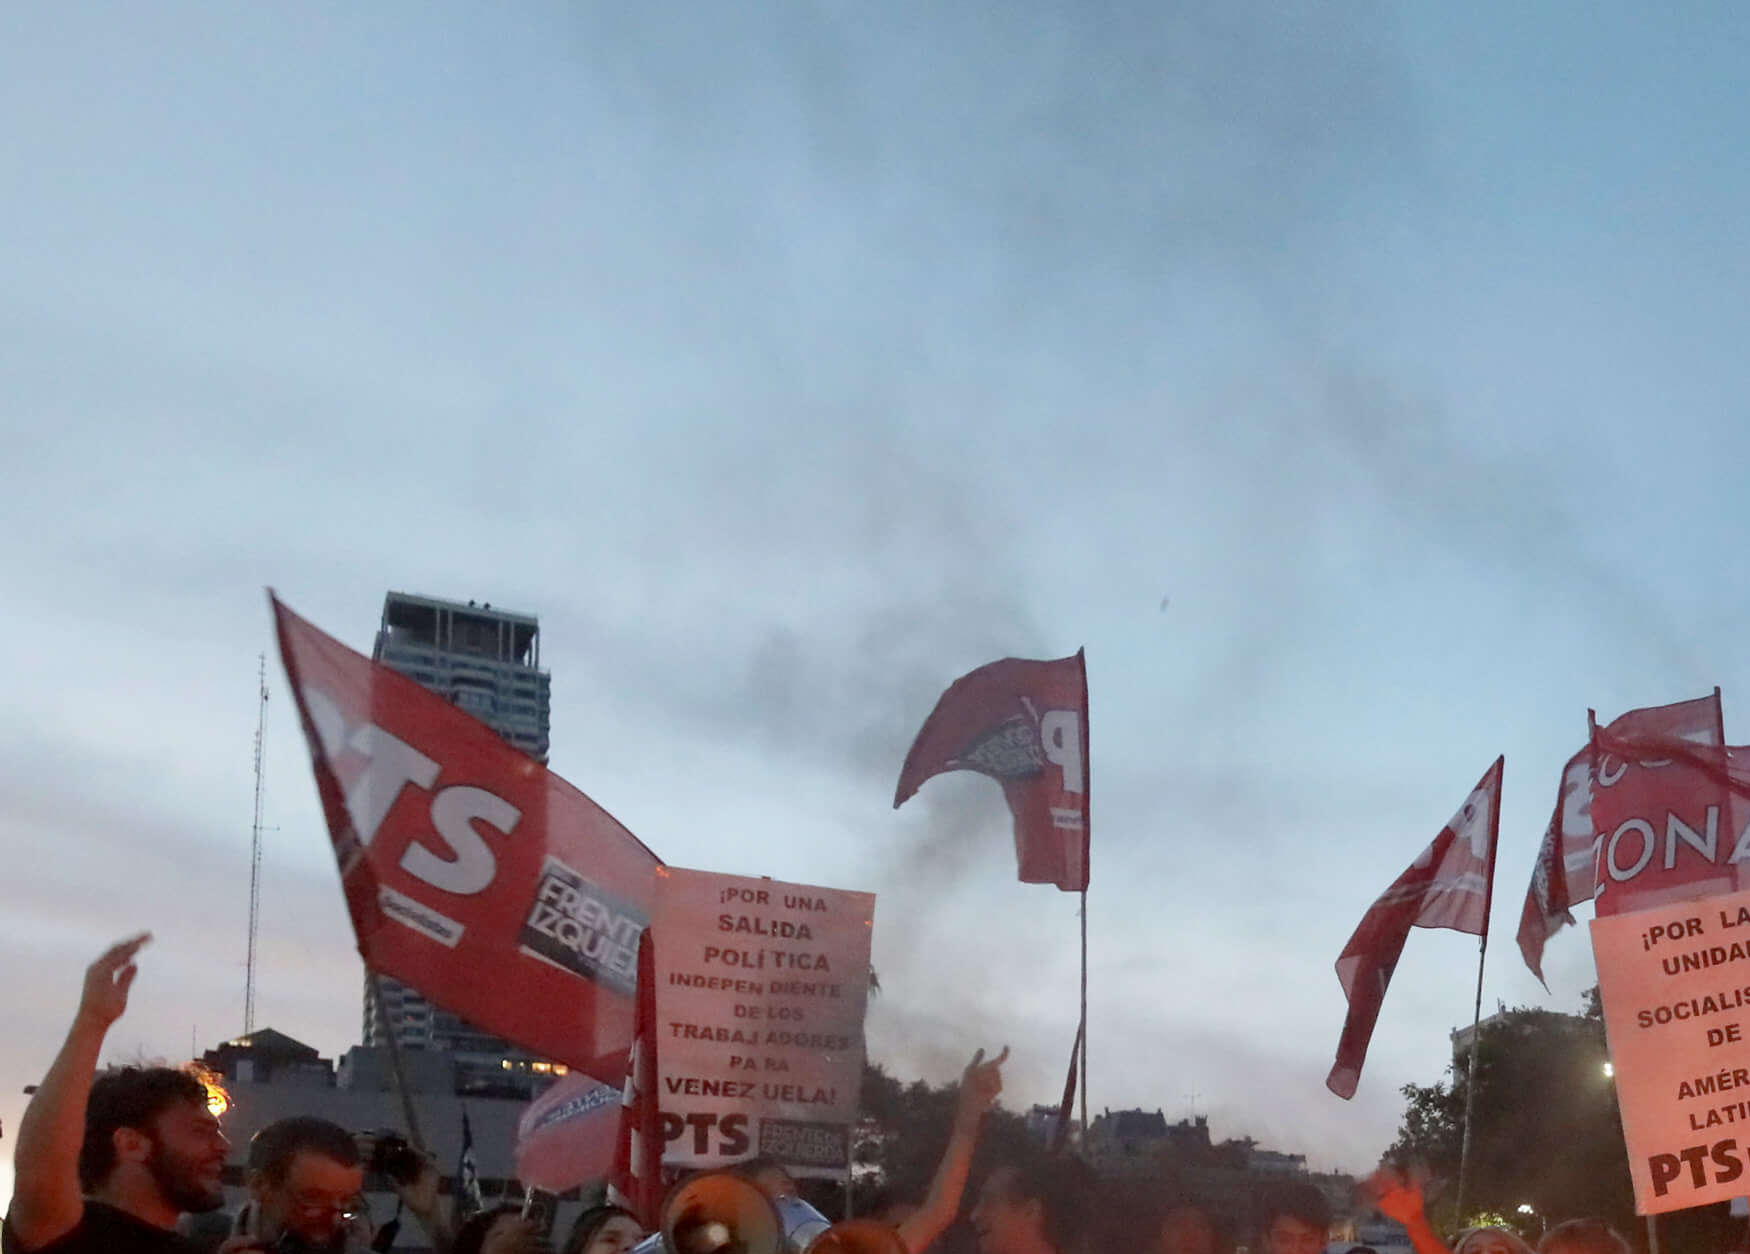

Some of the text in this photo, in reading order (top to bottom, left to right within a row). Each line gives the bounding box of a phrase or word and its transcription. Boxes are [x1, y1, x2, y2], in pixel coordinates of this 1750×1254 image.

[539, 877, 641, 950] FRENT
[784, 895, 827, 912] UNA
[527, 904, 638, 975] IZQUIE
[718, 914, 812, 940] SALIDA
[734, 1004, 804, 1021] DE LOS
[1707, 1024, 1742, 1047] DE
[658, 1112, 750, 1156] PTS
[1648, 1139, 1743, 1198] PTS
